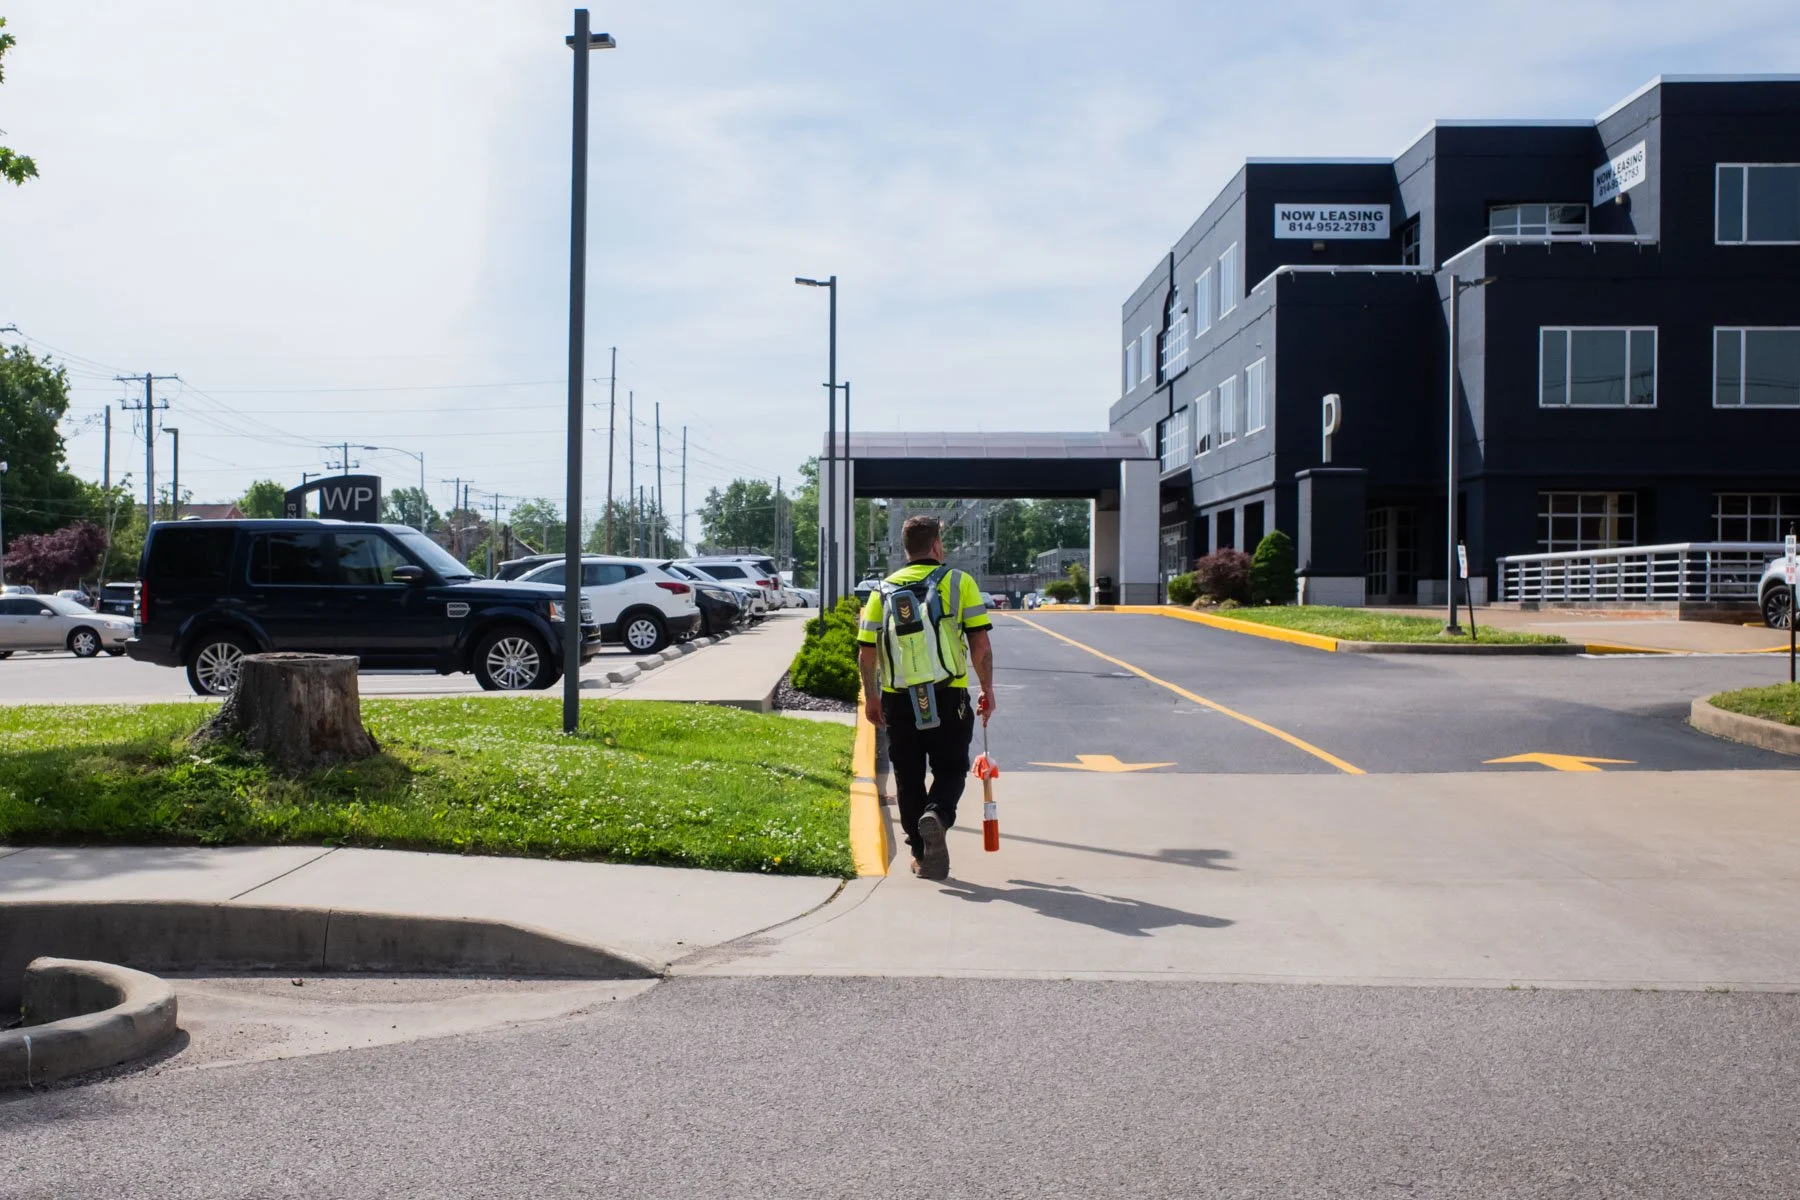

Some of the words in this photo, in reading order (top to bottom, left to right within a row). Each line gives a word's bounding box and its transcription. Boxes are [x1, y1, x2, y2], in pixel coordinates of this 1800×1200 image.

[1596, 168, 1612, 188] NOW
[1612, 150, 1643, 176] LEASING
[1281, 211, 1315, 221] NOW
[1320, 211, 1384, 221] LEASING
[1289, 222, 1376, 232] 814-952-2783
[1323, 393, 1341, 463] P
[322, 487, 373, 511] WP
